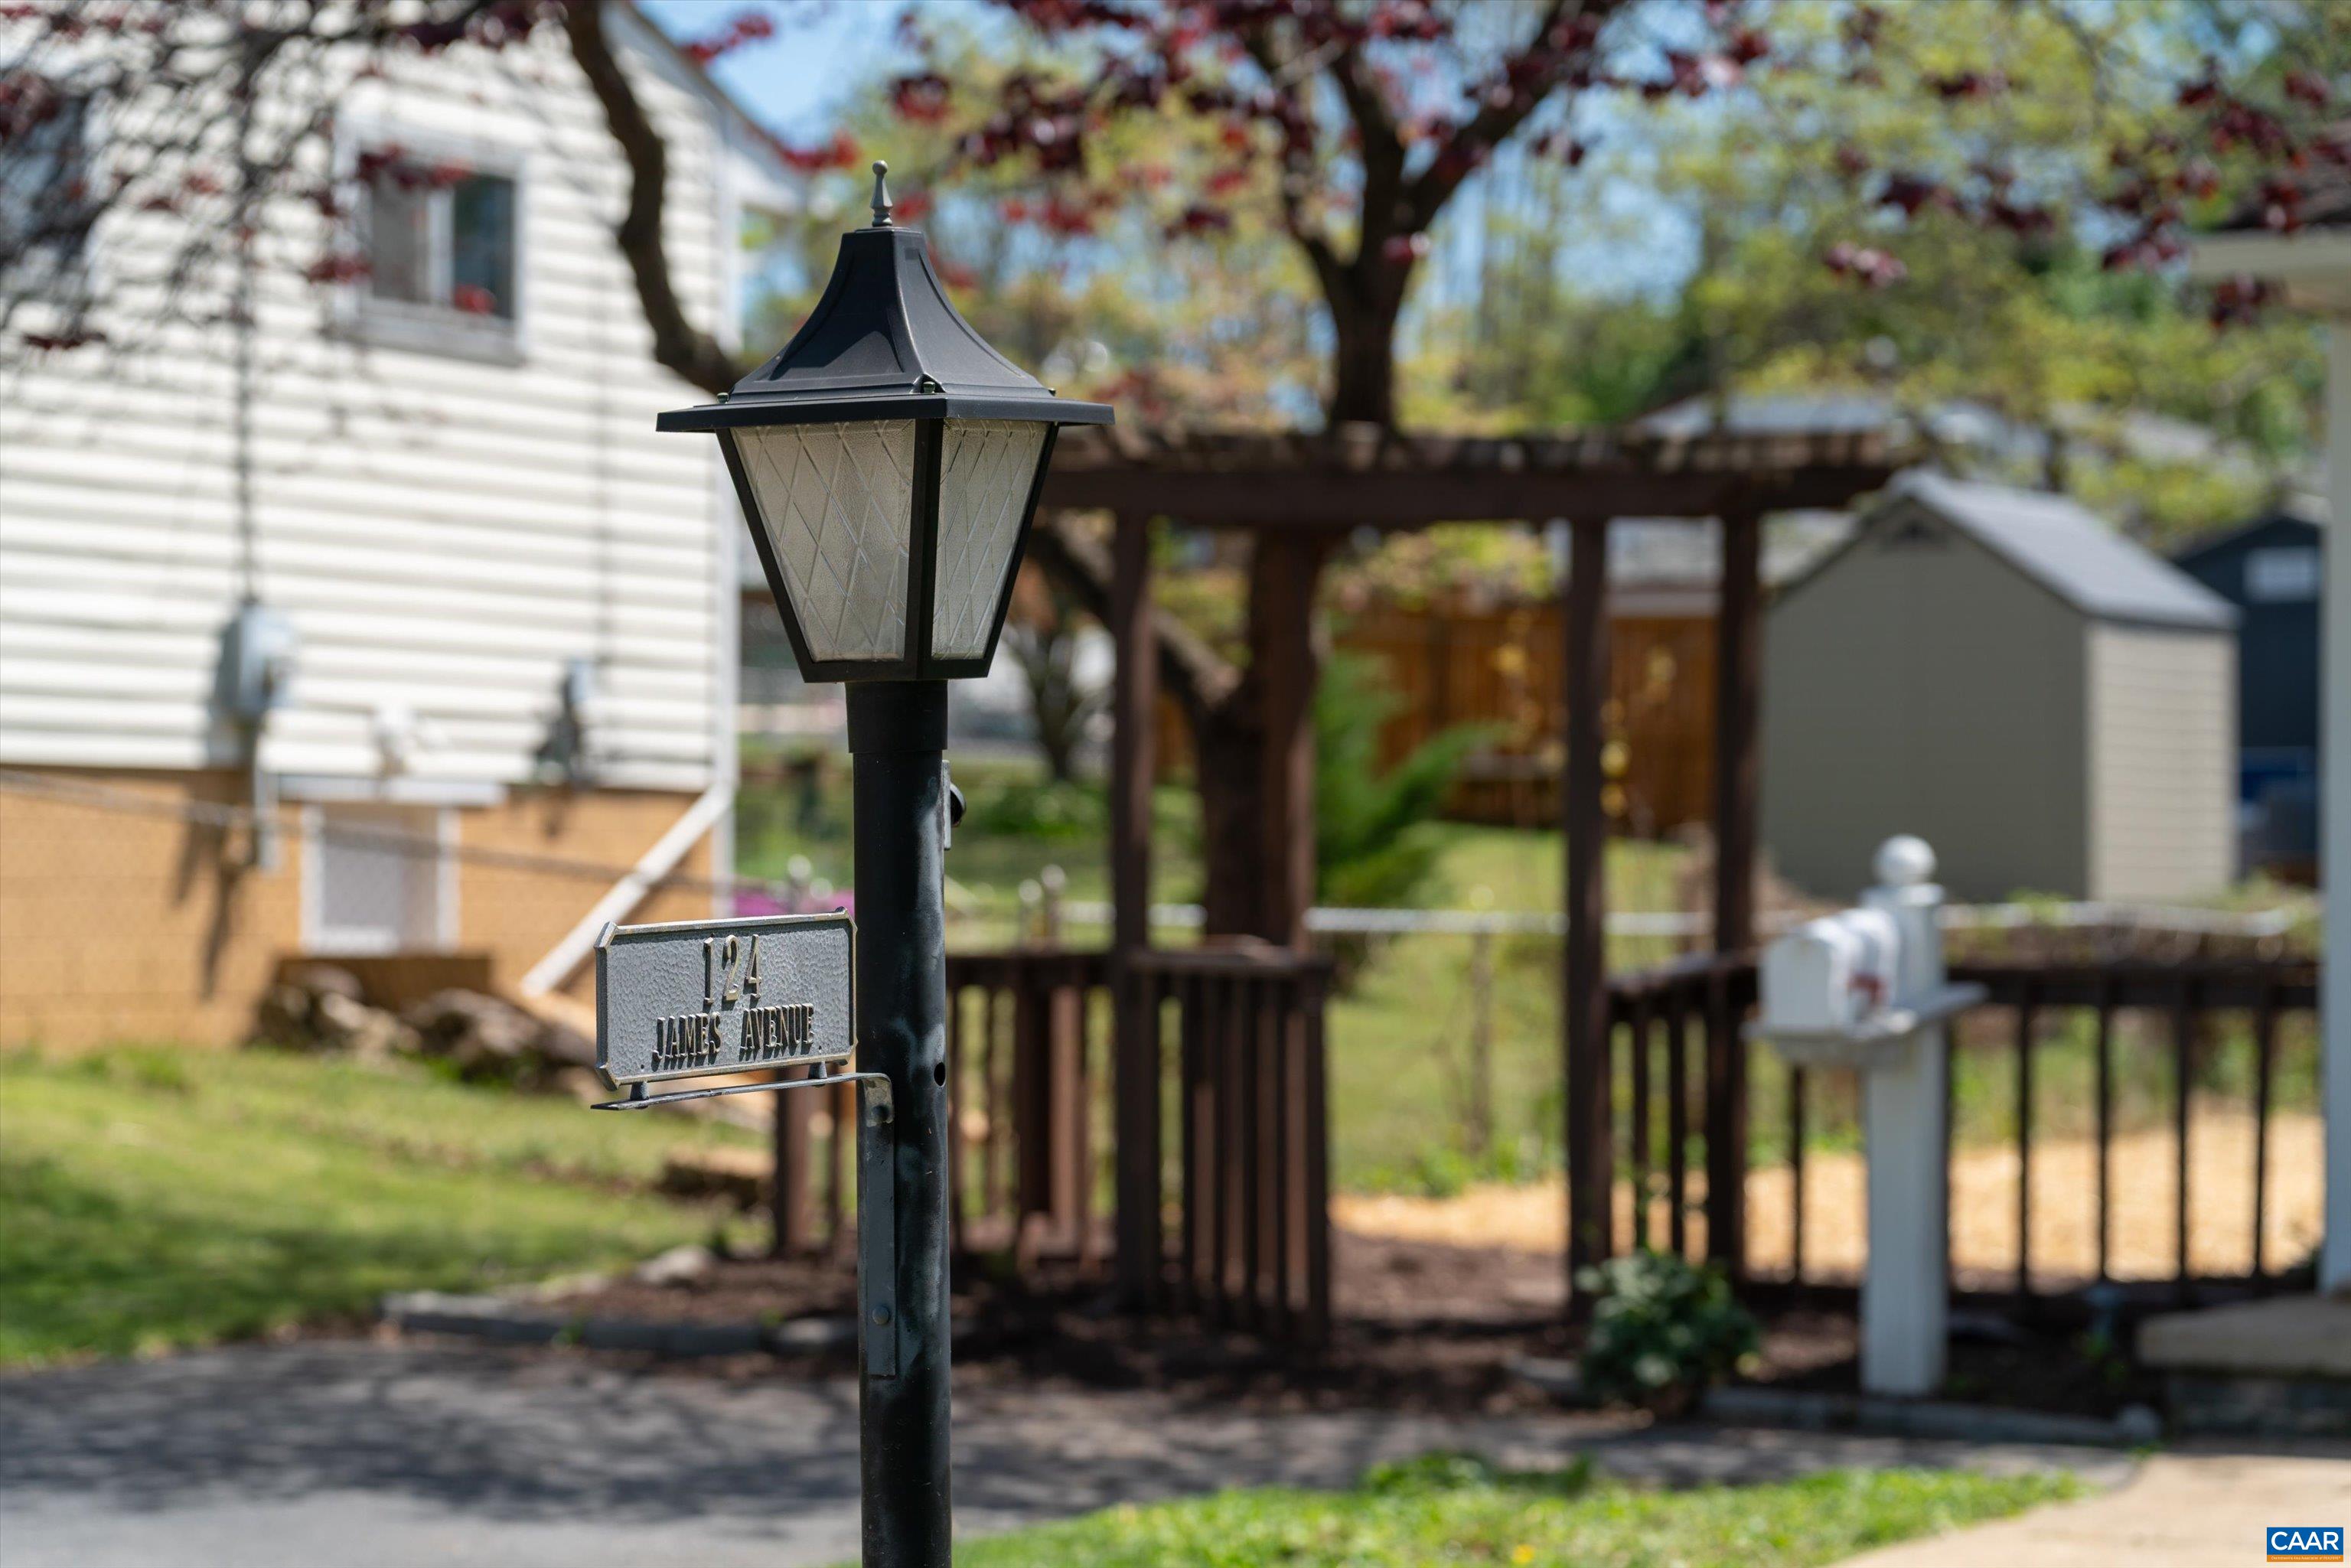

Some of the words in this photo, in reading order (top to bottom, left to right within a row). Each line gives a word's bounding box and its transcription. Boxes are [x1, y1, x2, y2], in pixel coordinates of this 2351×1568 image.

[703, 934, 762, 1006] 124
[653, 1012, 722, 1061] JAMES
[740, 1002, 815, 1052] AVENUE
